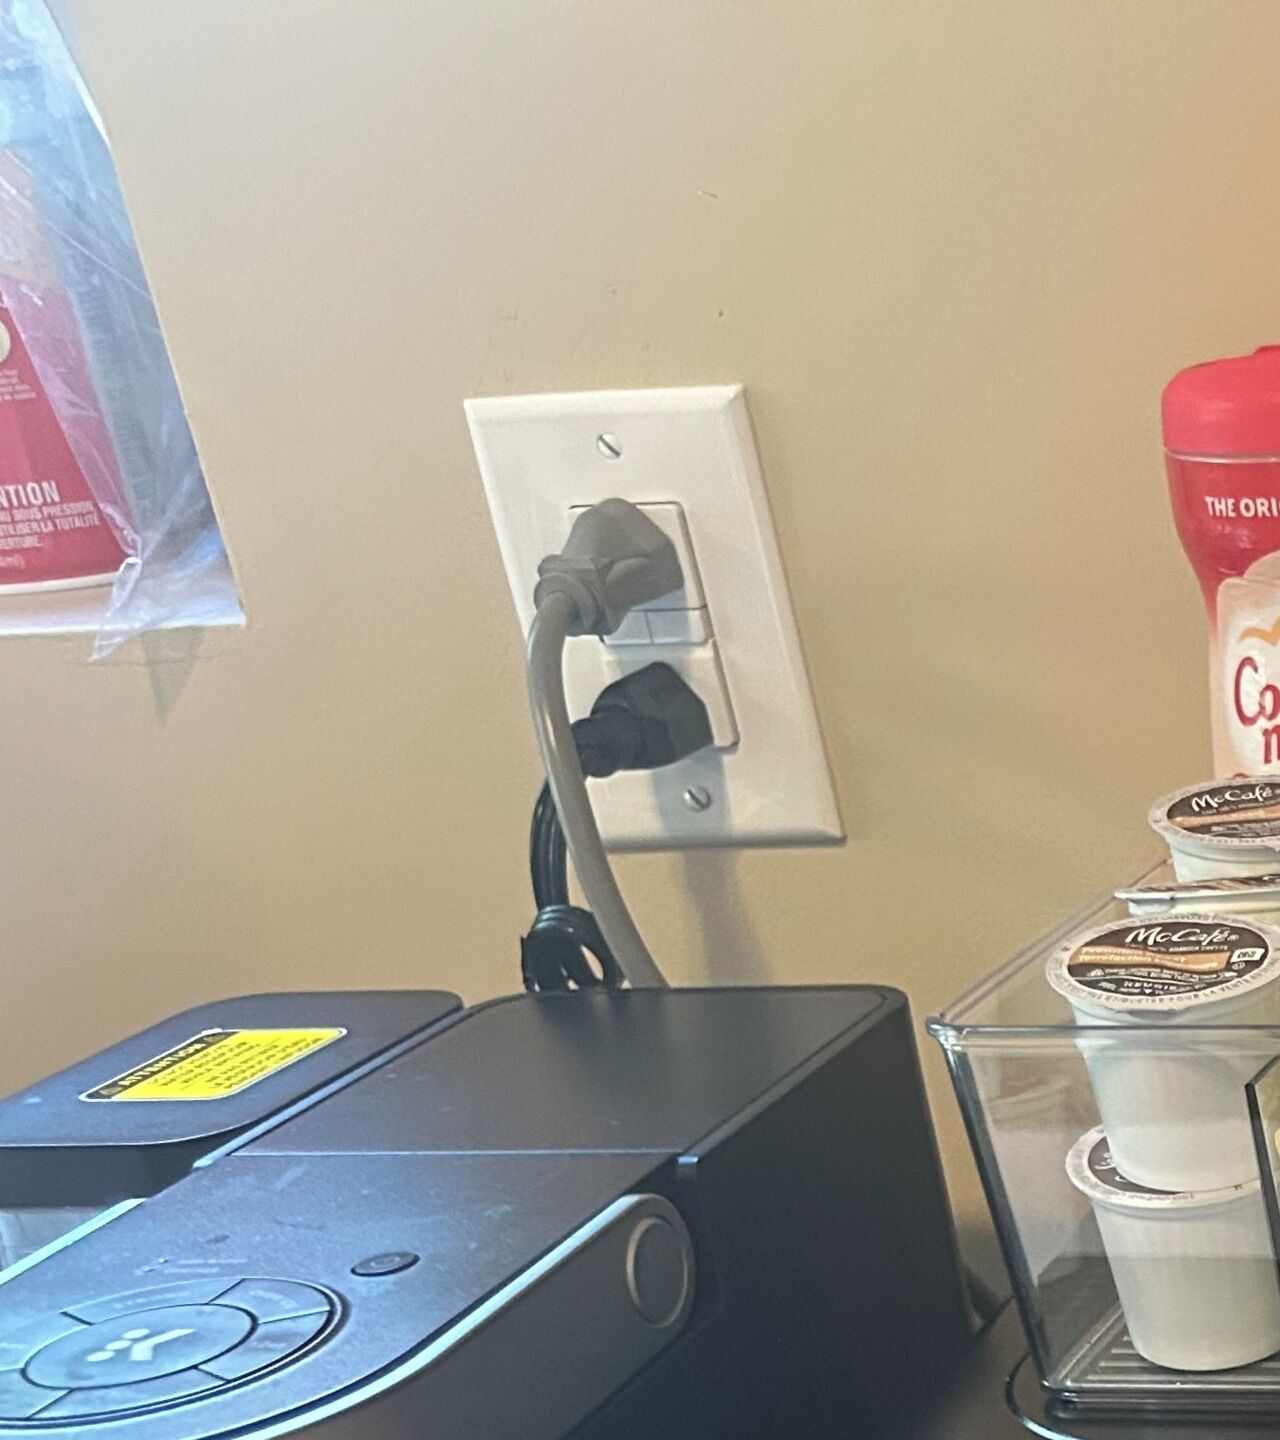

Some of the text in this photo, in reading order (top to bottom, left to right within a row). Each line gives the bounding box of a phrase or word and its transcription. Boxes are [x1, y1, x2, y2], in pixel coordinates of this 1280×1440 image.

[1204, 496, 1236, 518] THE
[1190, 784, 1274, 812] McCafé
[1125, 926, 1231, 945] McCafé
